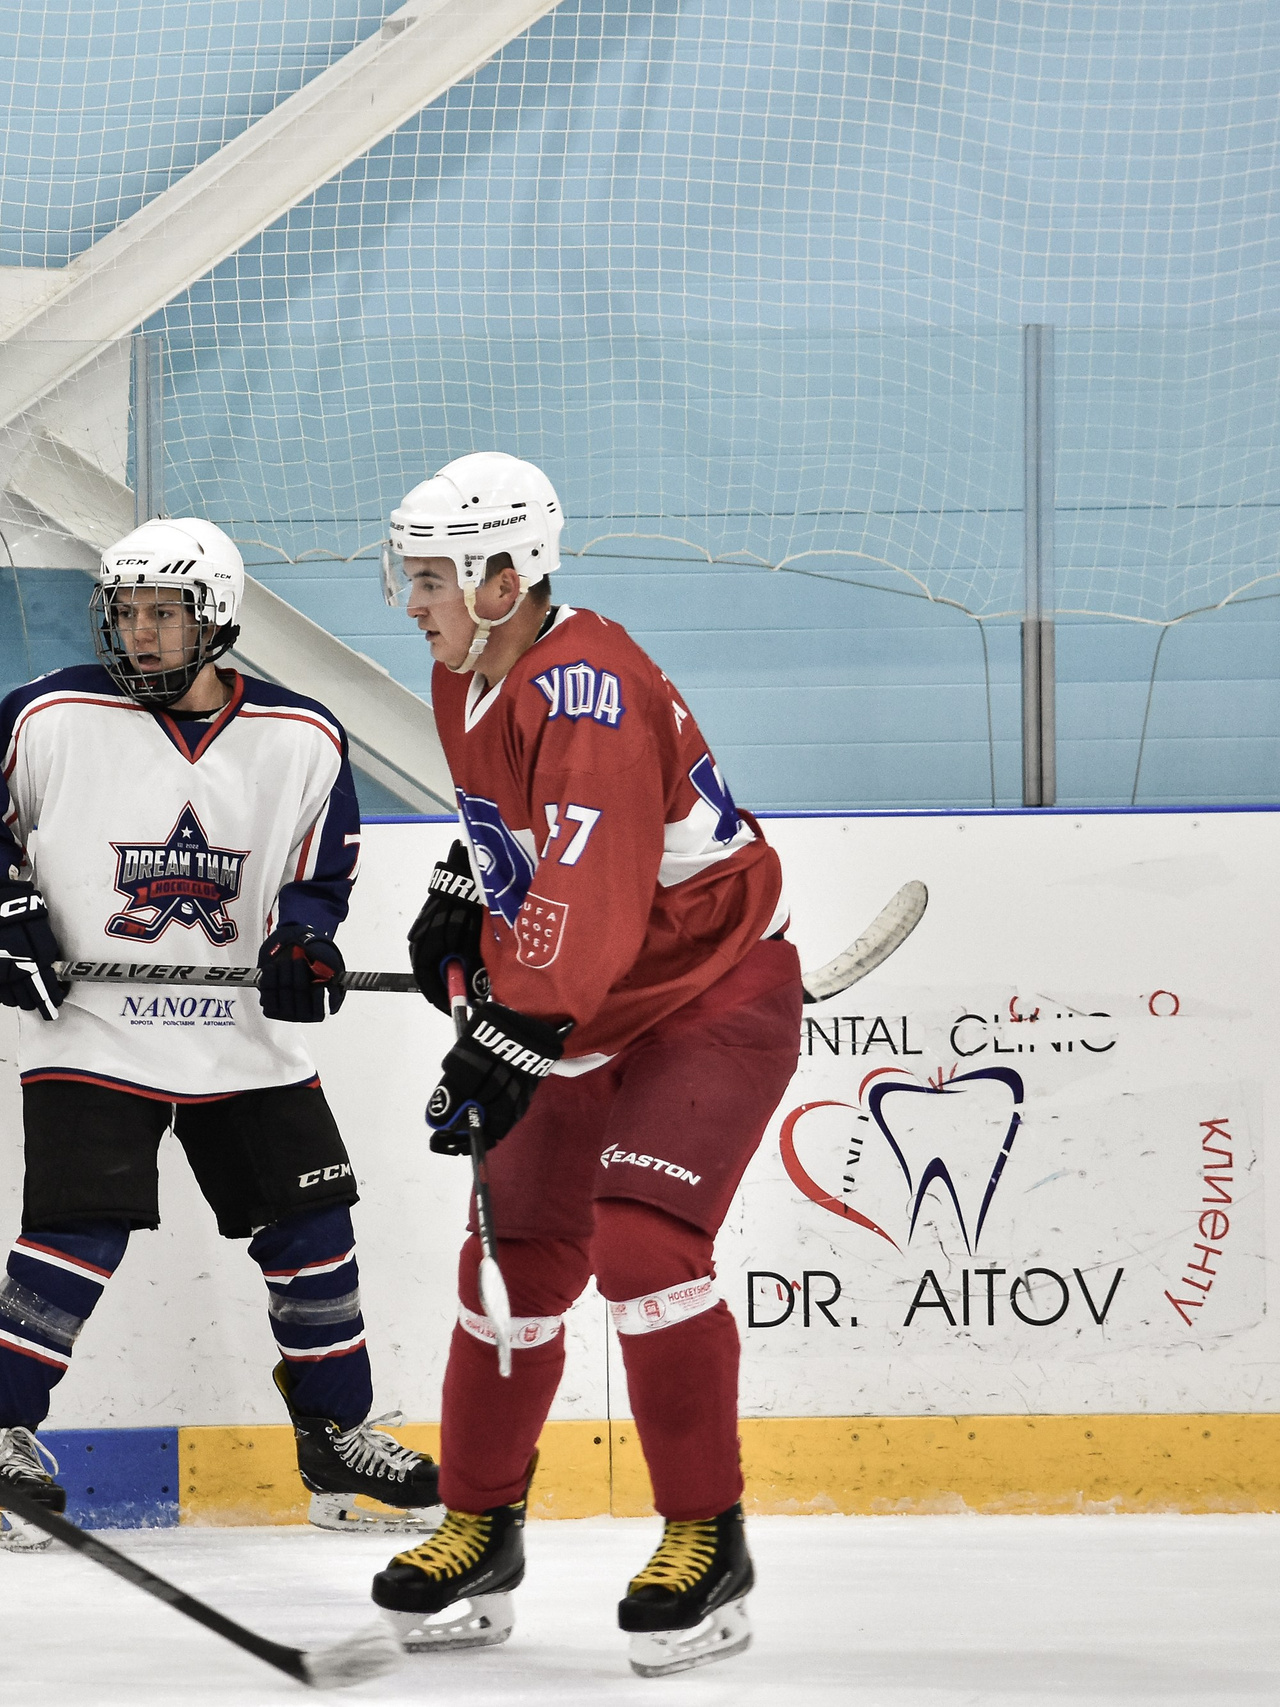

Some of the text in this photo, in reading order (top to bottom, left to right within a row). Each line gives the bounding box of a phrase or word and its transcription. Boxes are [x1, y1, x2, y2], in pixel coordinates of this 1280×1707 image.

[482, 514, 527, 530] BAUER
[214, 572, 232, 580] CCM
[534, 662, 622, 725] УФА
[122, 849, 191, 884] DREAM
[523, 902, 556, 921] UFA
[70, 961, 196, 980] SILVER
[120, 996, 235, 1019] NANOTEK
[799, 1016, 923, 1055] NTAL
[298, 1162, 352, 1188] CCM
[610, 1150, 701, 1186] EASTON
[746, 1267, 1124, 1328] DR. AITOV
